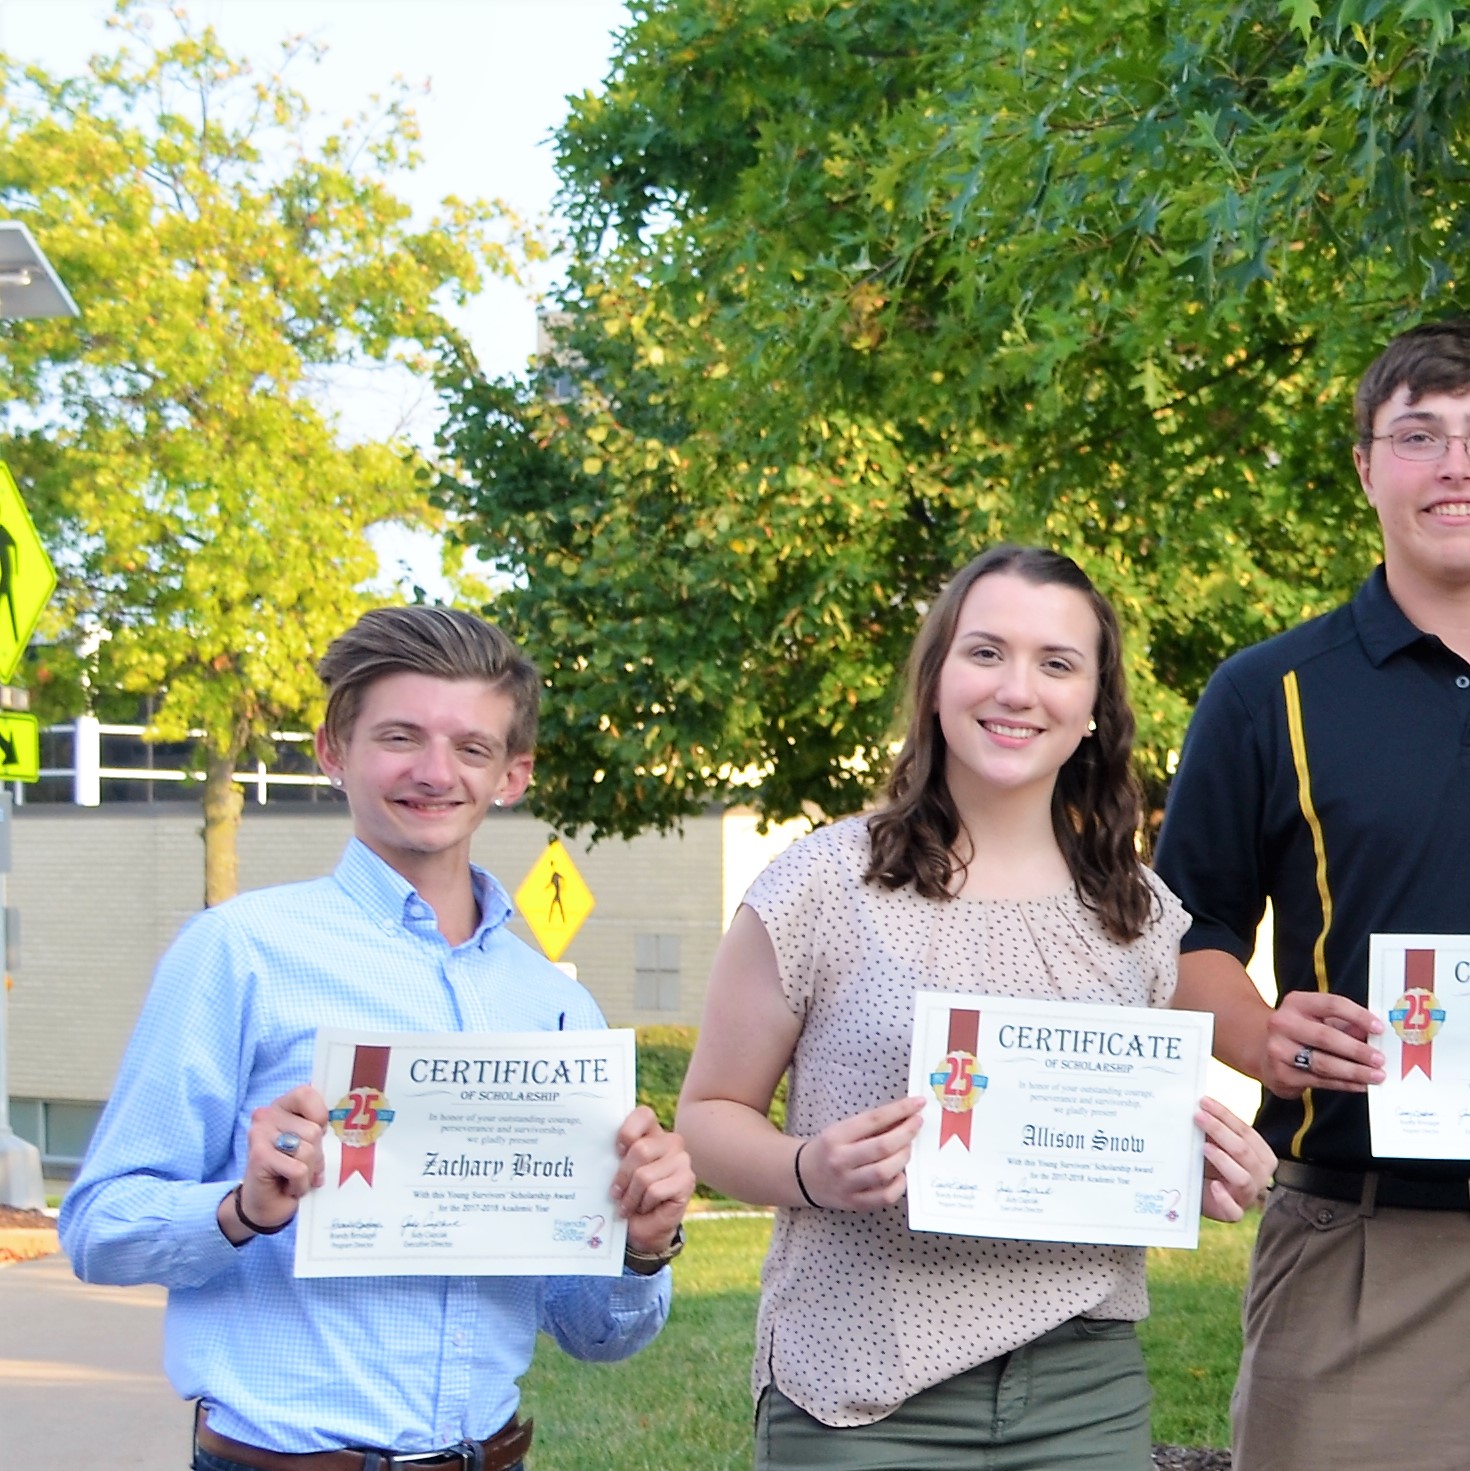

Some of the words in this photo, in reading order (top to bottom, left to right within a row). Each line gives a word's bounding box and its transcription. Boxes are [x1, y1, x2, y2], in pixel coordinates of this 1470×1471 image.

[1404, 995, 1432, 1029] 25
[998, 1024, 1182, 1060] CERTIFICATE
[409, 1058, 609, 1085] CERTIFICATE
[944, 1058, 973, 1096] 25
[1044, 1059, 1058, 1069] OF
[1061, 1060, 1133, 1074] SCHOLARSHIP
[460, 1090, 476, 1099] OF
[478, 1090, 559, 1100] SCHOLARSHIP
[343, 1094, 379, 1129] 25
[1022, 1125, 1085, 1150] Allison
[1091, 1130, 1145, 1153] Snow
[422, 1152, 504, 1182] Zachary
[513, 1154, 574, 1179] Brock
